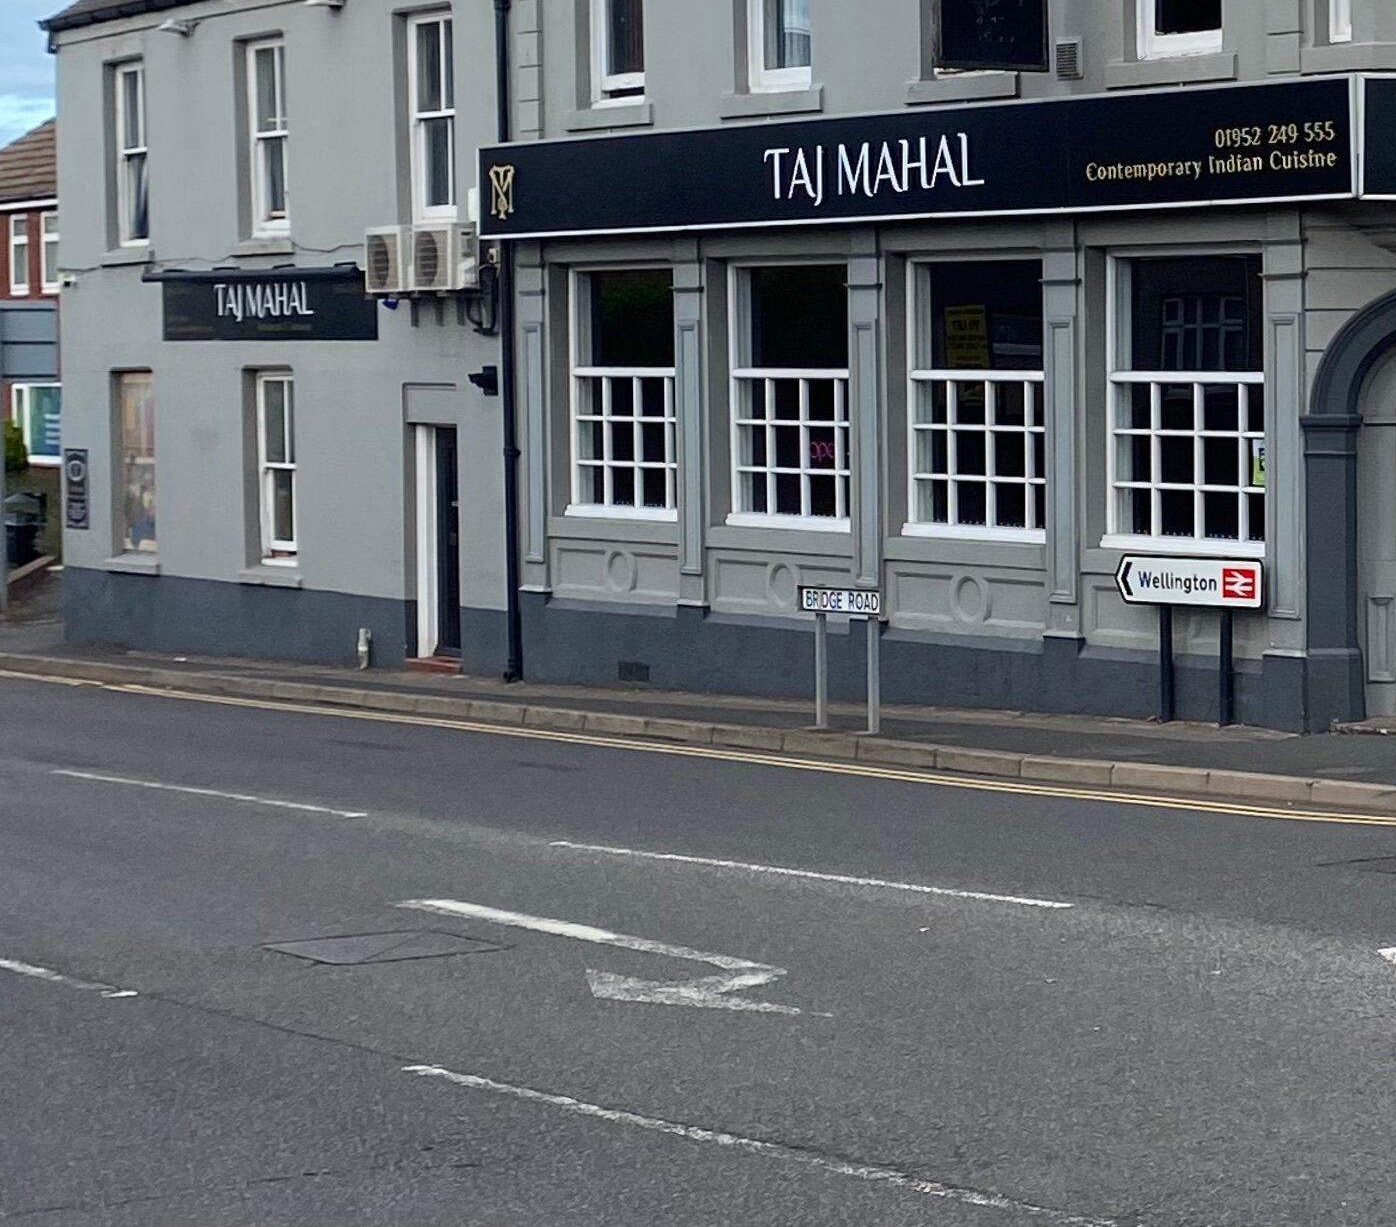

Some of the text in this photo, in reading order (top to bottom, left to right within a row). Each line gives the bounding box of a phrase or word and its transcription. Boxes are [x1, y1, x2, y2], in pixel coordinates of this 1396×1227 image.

[1215, 121, 1336, 148] 01952 249 555
[763, 132, 985, 207] TAJ MAHAL
[1086, 150, 1338, 181] Contemporary Indian Cuisine
[214, 281, 315, 322] TAJ MAHAL
[1138, 571, 1217, 594] Wellington
[848, 591, 879, 611] ROAD
